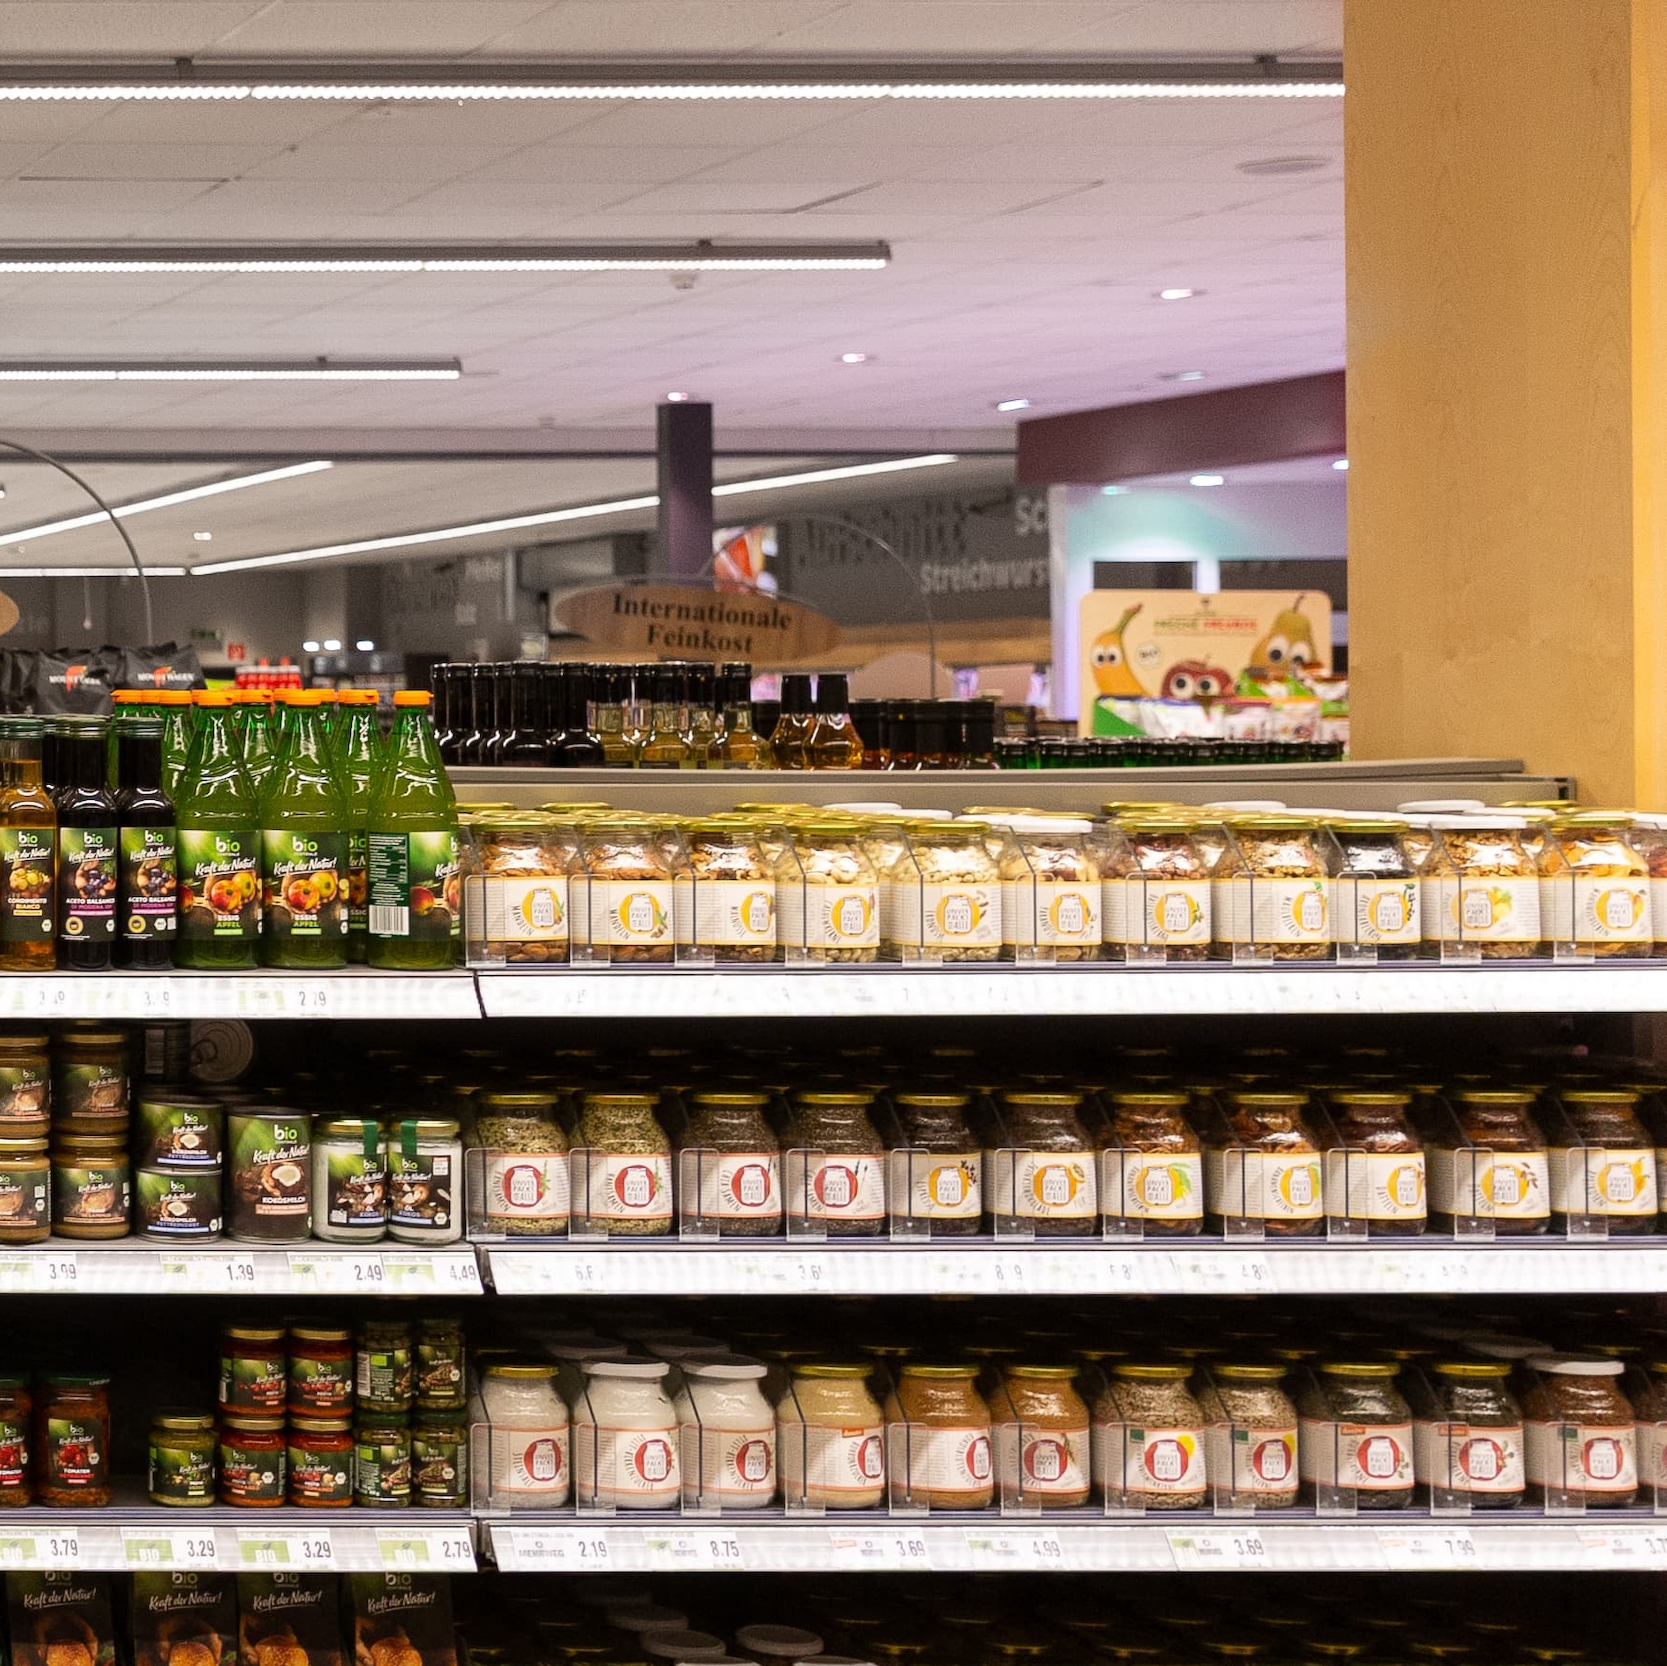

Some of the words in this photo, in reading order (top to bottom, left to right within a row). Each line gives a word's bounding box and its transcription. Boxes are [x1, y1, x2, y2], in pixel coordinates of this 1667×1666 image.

[614, 596, 791, 631] Internationale
[647, 626, 752, 653] Feinkost
[1234, 1540, 1264, 1556] 3.69
